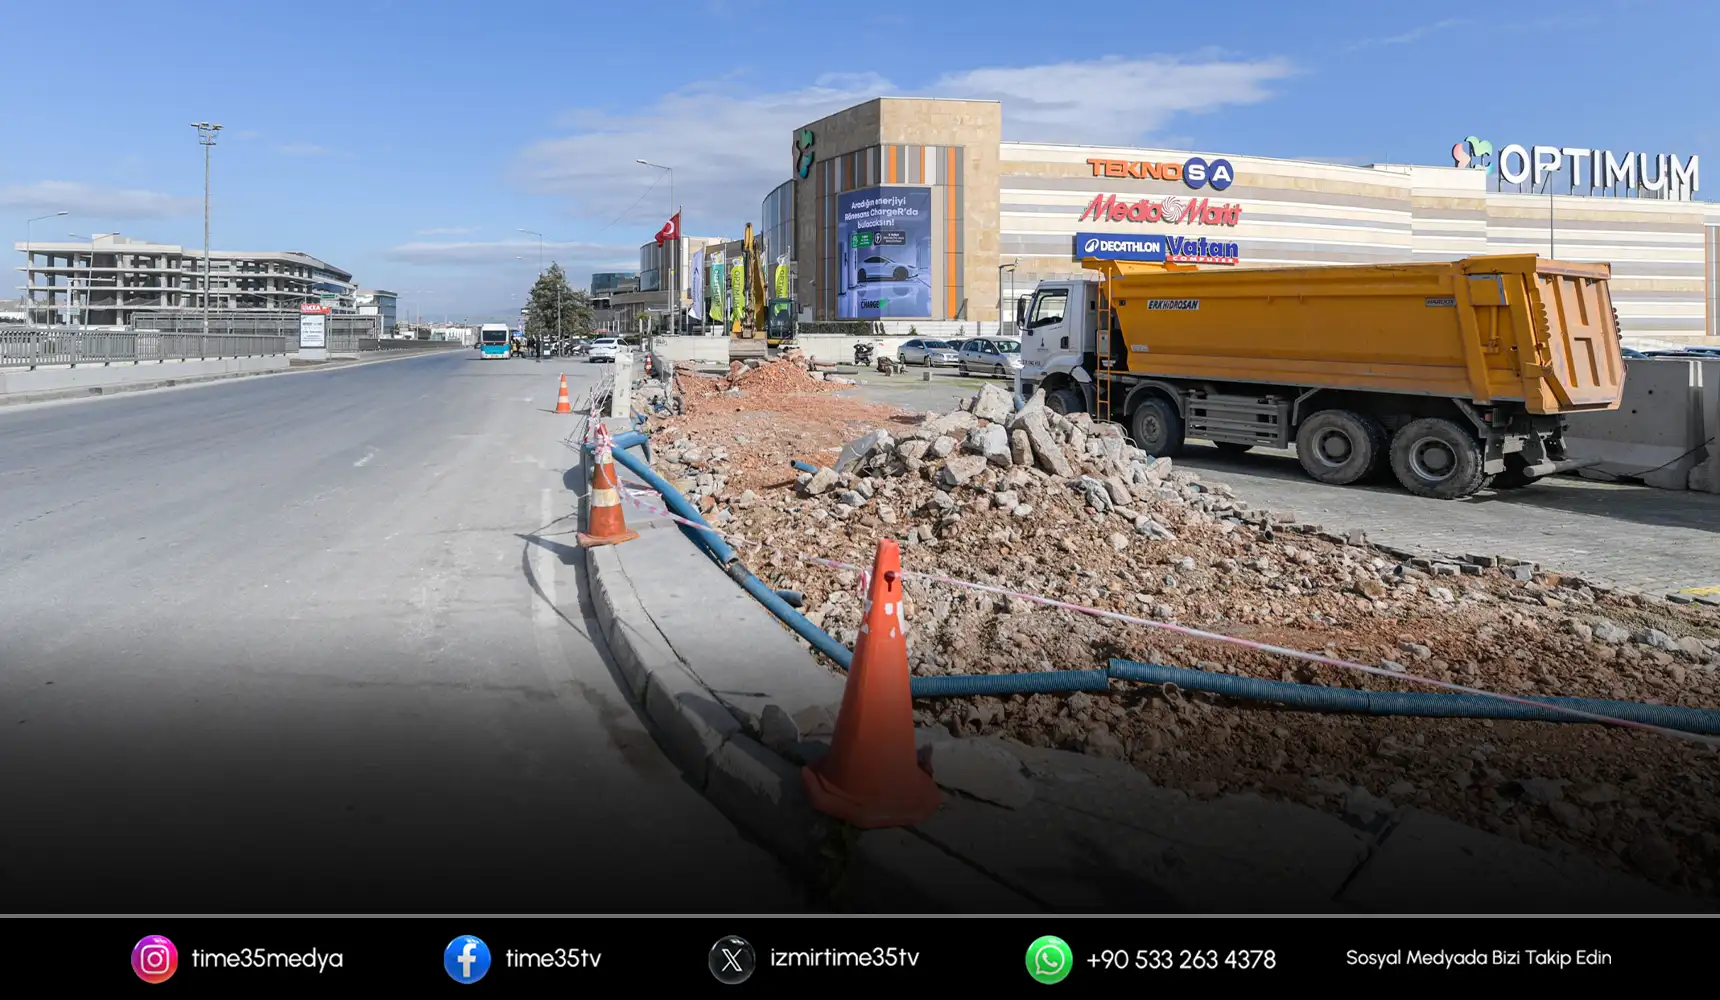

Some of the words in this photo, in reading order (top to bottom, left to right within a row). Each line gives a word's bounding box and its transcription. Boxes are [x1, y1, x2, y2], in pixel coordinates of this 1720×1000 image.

[1087, 158, 1232, 182] TEKNOSA
[1500, 144, 1699, 192] OPTIMUM
[875, 197, 906, 206] enerjiyi
[1079, 194, 1162, 223] Media
[1178, 198, 1242, 226] Markt
[844, 210, 869, 221] Rönesans
[1100, 241, 1160, 253] DECATHLON
[1167, 236, 1239, 257] Vatan
